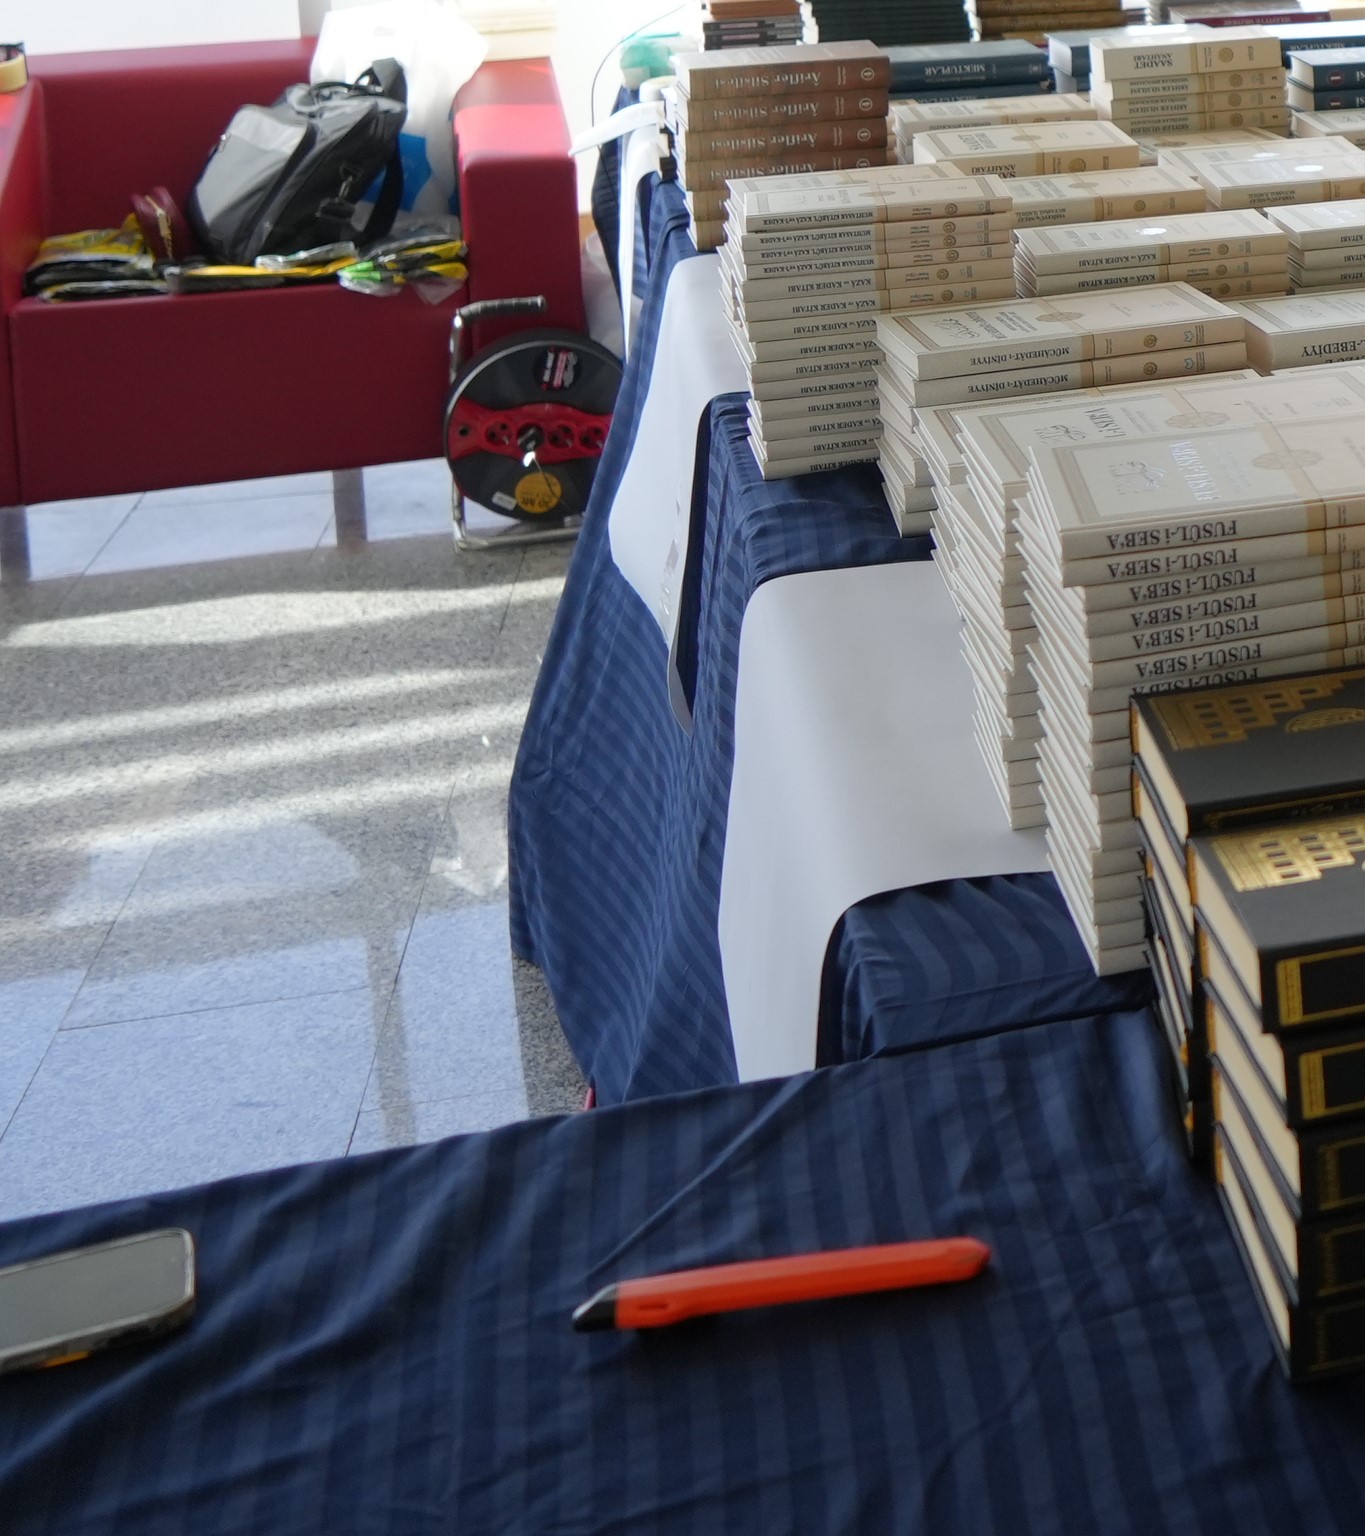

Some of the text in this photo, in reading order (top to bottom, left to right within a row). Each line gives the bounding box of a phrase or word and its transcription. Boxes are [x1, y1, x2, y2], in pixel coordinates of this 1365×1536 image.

[1133, 53, 1172, 62] ANAHTARI
[1134, 59, 1173, 69] SAADET
[924, 63, 985, 76] MEKTUPLAR
[716, 72, 820, 89] Ârifler Silsilesi
[714, 102, 819, 119] Ârifler Silsilesi
[711, 133, 817, 150] Ârifler Silsilesi
[971, 164, 1016, 173] ANAHTARI
[1079, 253, 1156, 267] KAZÂ KADER KİTABI
[788, 279, 871, 293] KAZÂ KADER KİTABI
[1078, 274, 1155, 288] KAZÂ KADER KİTABI
[793, 300, 875, 313] KAZÂ KADER KİTABI
[793, 324, 819, 334] KİTABI
[822, 322, 847, 331] KADER
[801, 341, 876, 354] AZÂ KADER KİTABI
[796, 359, 878, 374] KAZÂ KADER KİTABI
[801, 379, 878, 394] AZÂ KADER KİTABI
[808, 403, 834, 412] KİTABI
[836, 400, 862, 409] KADER
[809, 423, 835, 432] KİTABI
[838, 420, 863, 429] KADER
[814, 439, 867, 452] KADER KİTABI
[811, 461, 836, 471] KİTABI
[1107, 528, 1161, 550] SEB‘A
[1107, 557, 1161, 579] SEB‘A
[1130, 578, 1181, 602] SEB‘A
[1131, 604, 1182, 629] SEB‘A
[1133, 626, 1184, 650] SEB‘A
[1136, 654, 1187, 676] SEB‘A
